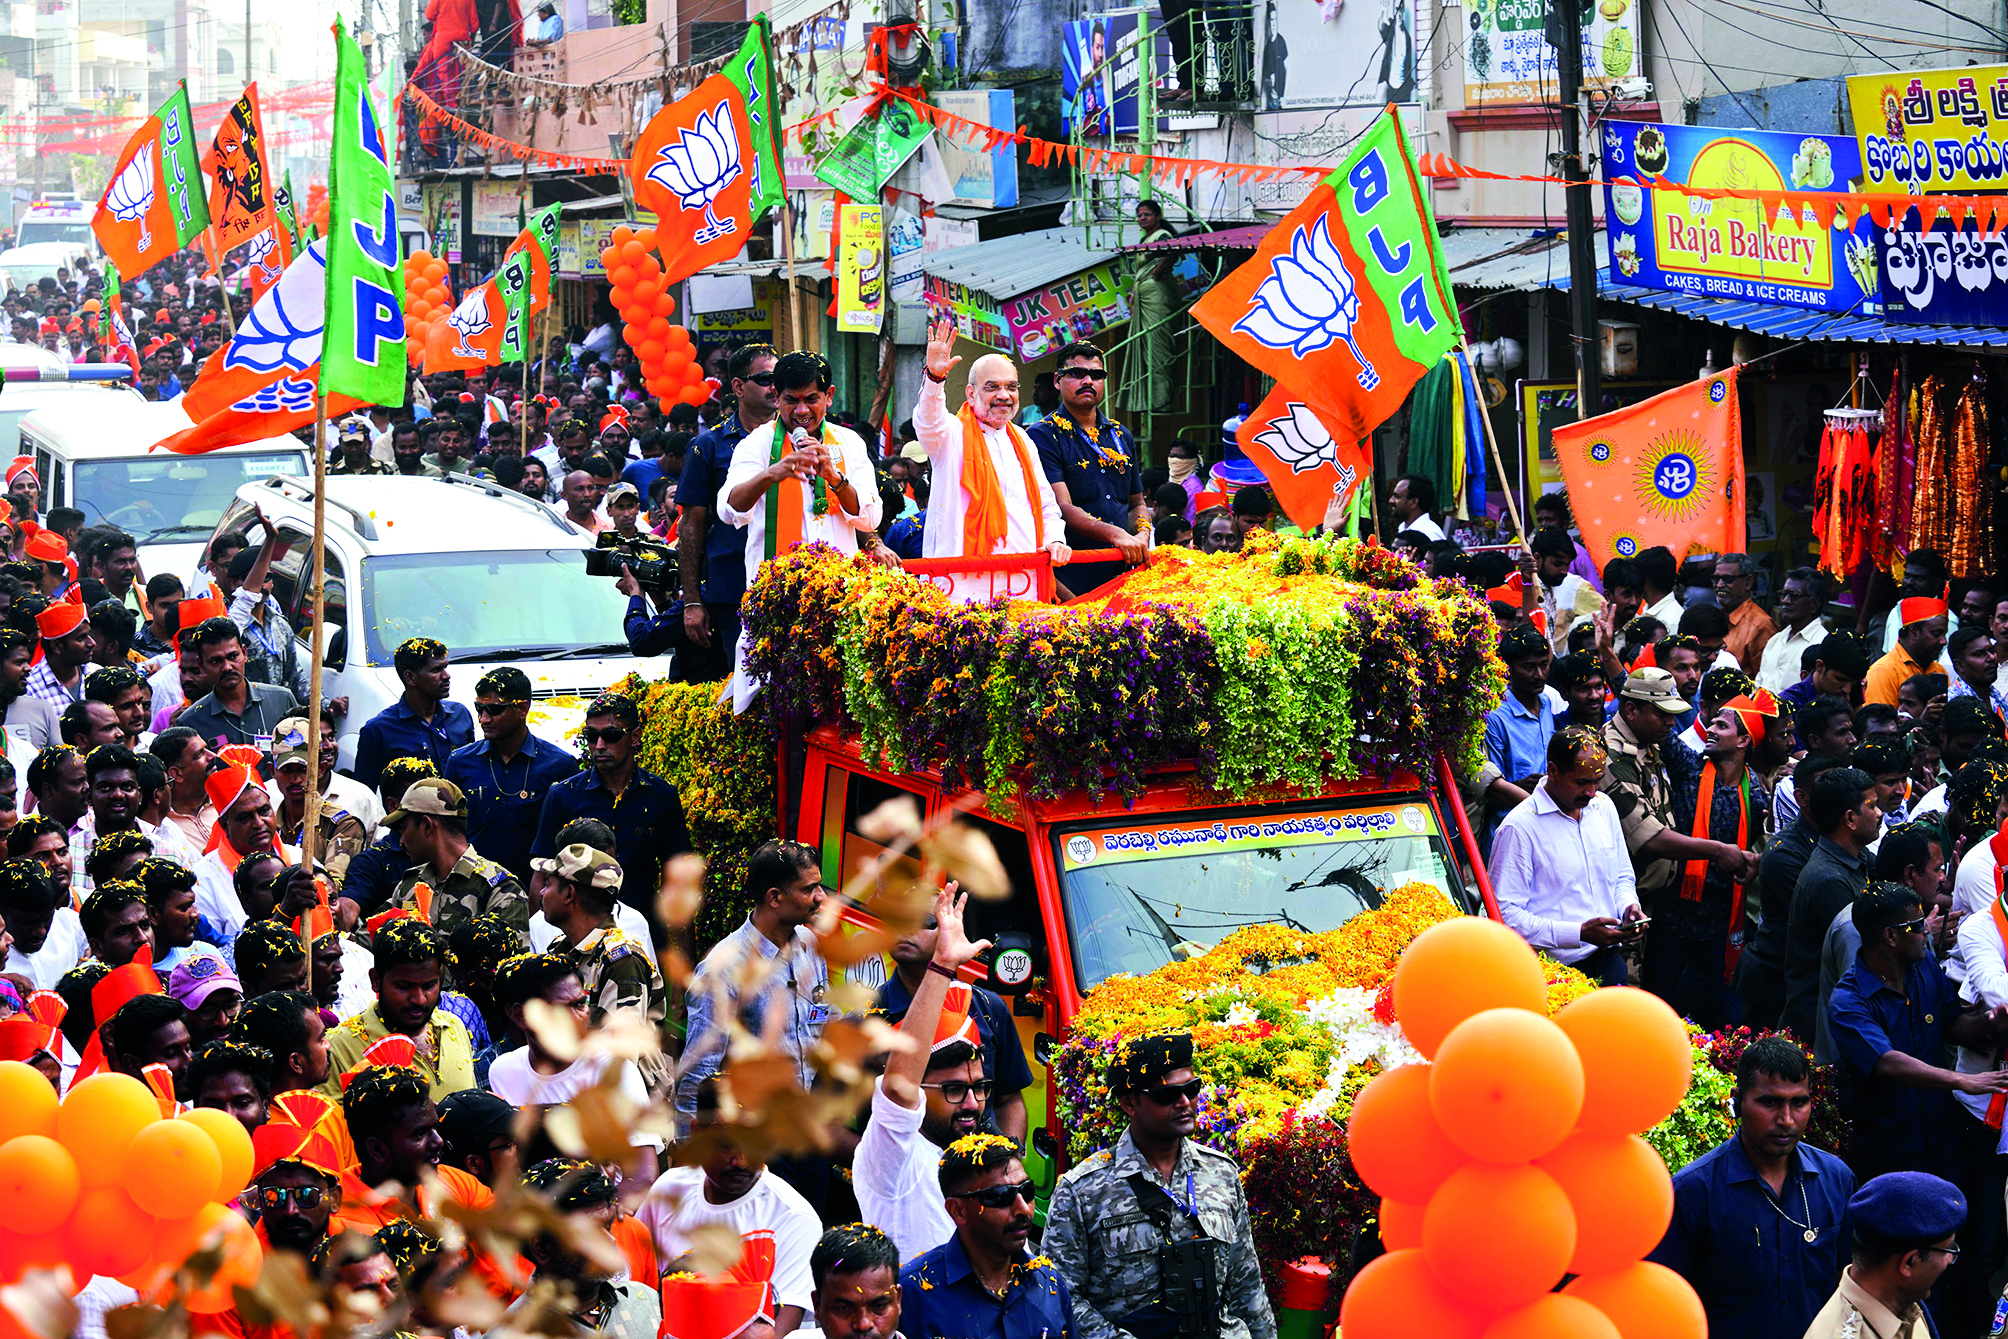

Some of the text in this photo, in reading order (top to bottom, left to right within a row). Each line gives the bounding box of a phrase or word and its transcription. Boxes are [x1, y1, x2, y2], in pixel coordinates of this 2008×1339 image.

[1903, 79, 1934, 125] శ్రీ
[1667, 214, 1816, 276] Raja Bakery
[939, 276, 965, 305] TEA
[1013, 291, 1051, 327] JK
[1049, 272, 1108, 310] TEA
[1664, 274, 1827, 306] CAKES, BREAD & ICE CREAMS
[1230, 823, 1261, 840] గారి
